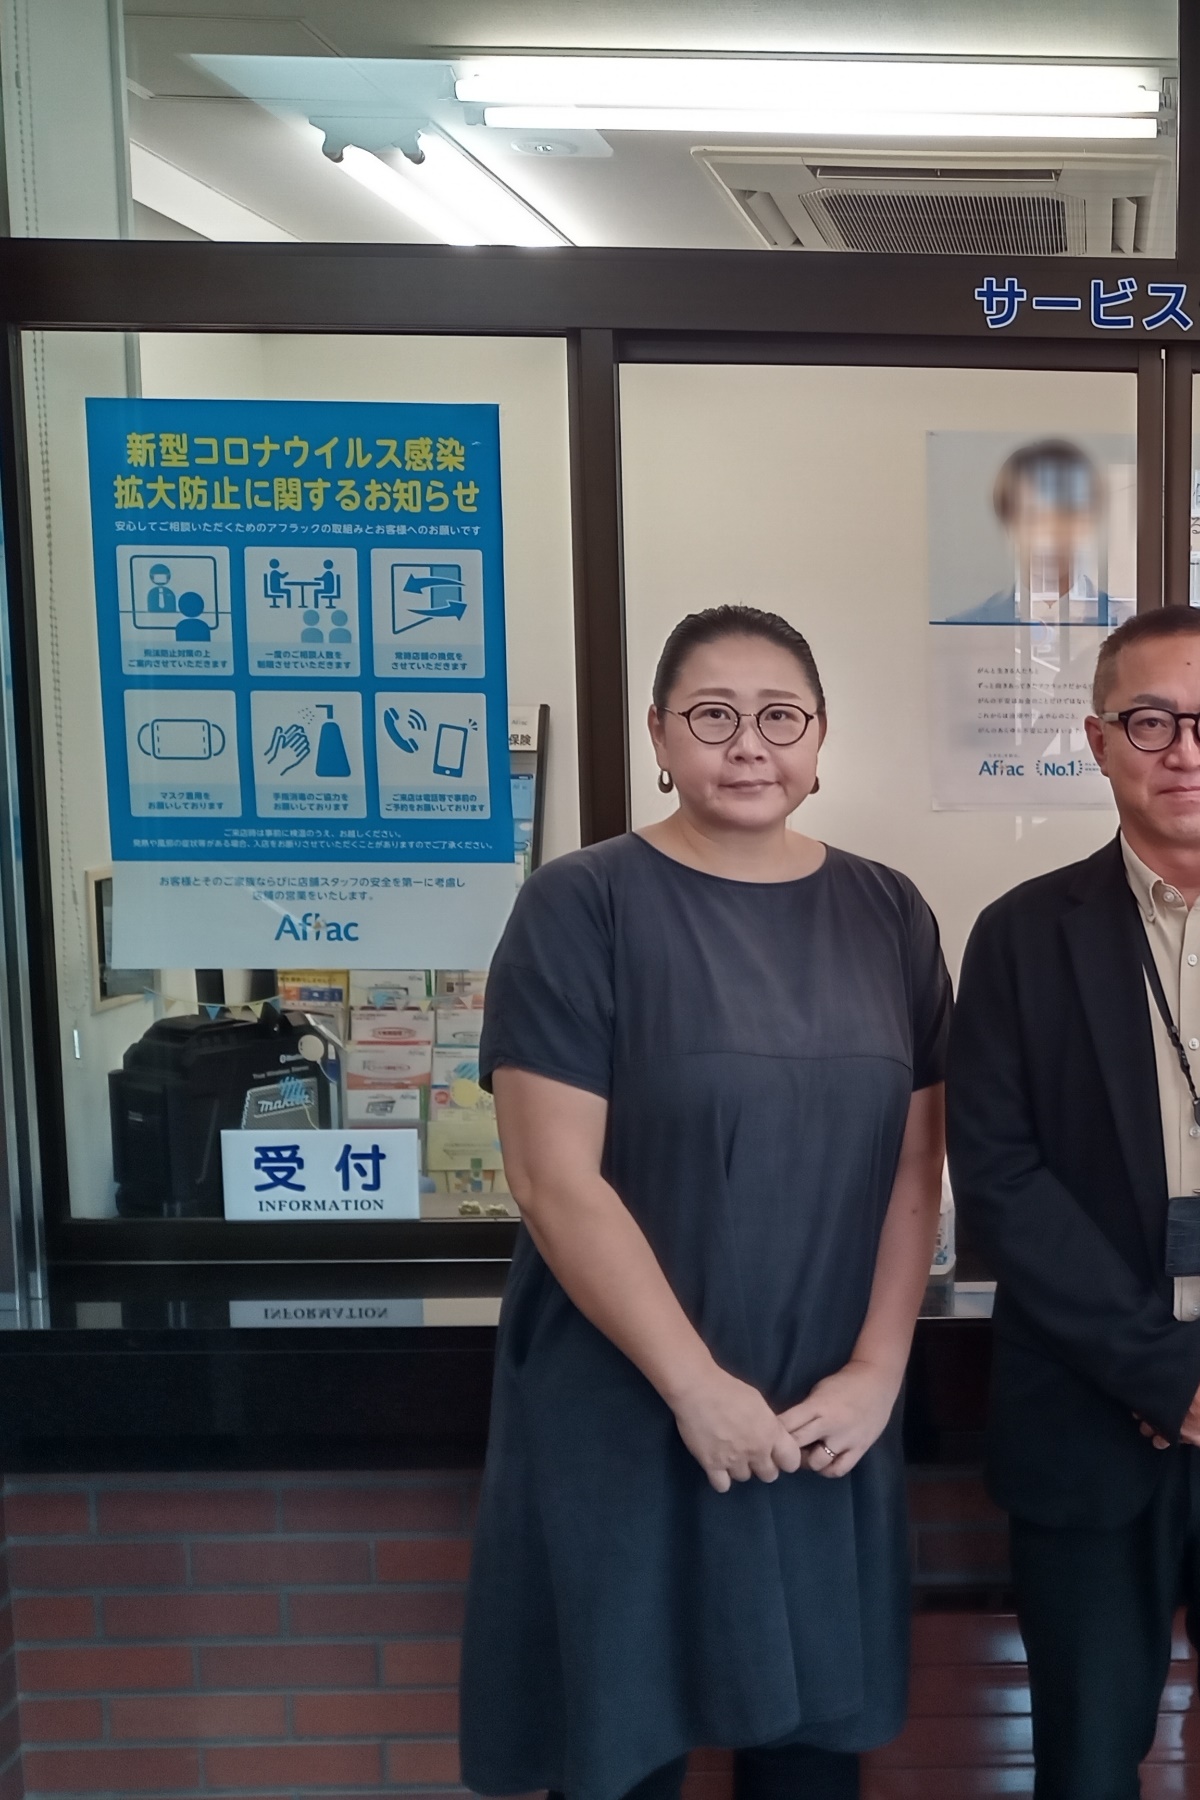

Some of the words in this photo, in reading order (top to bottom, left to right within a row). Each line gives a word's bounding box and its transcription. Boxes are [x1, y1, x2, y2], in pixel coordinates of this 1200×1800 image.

[126, 432, 466, 473] 新型コロナウイルス感染
[113, 474, 480, 514] 拡大防止に関するお知らせ
[391, 661, 468, 671] させていただきます
[1044, 760, 1075, 777] No.1
[148, 801, 224, 811] お願いしております
[273, 802, 349, 812] お願いしております
[385, 803, 485, 813] ご予約をお願いしております
[258, 1199, 385, 1212] INFORMATION
